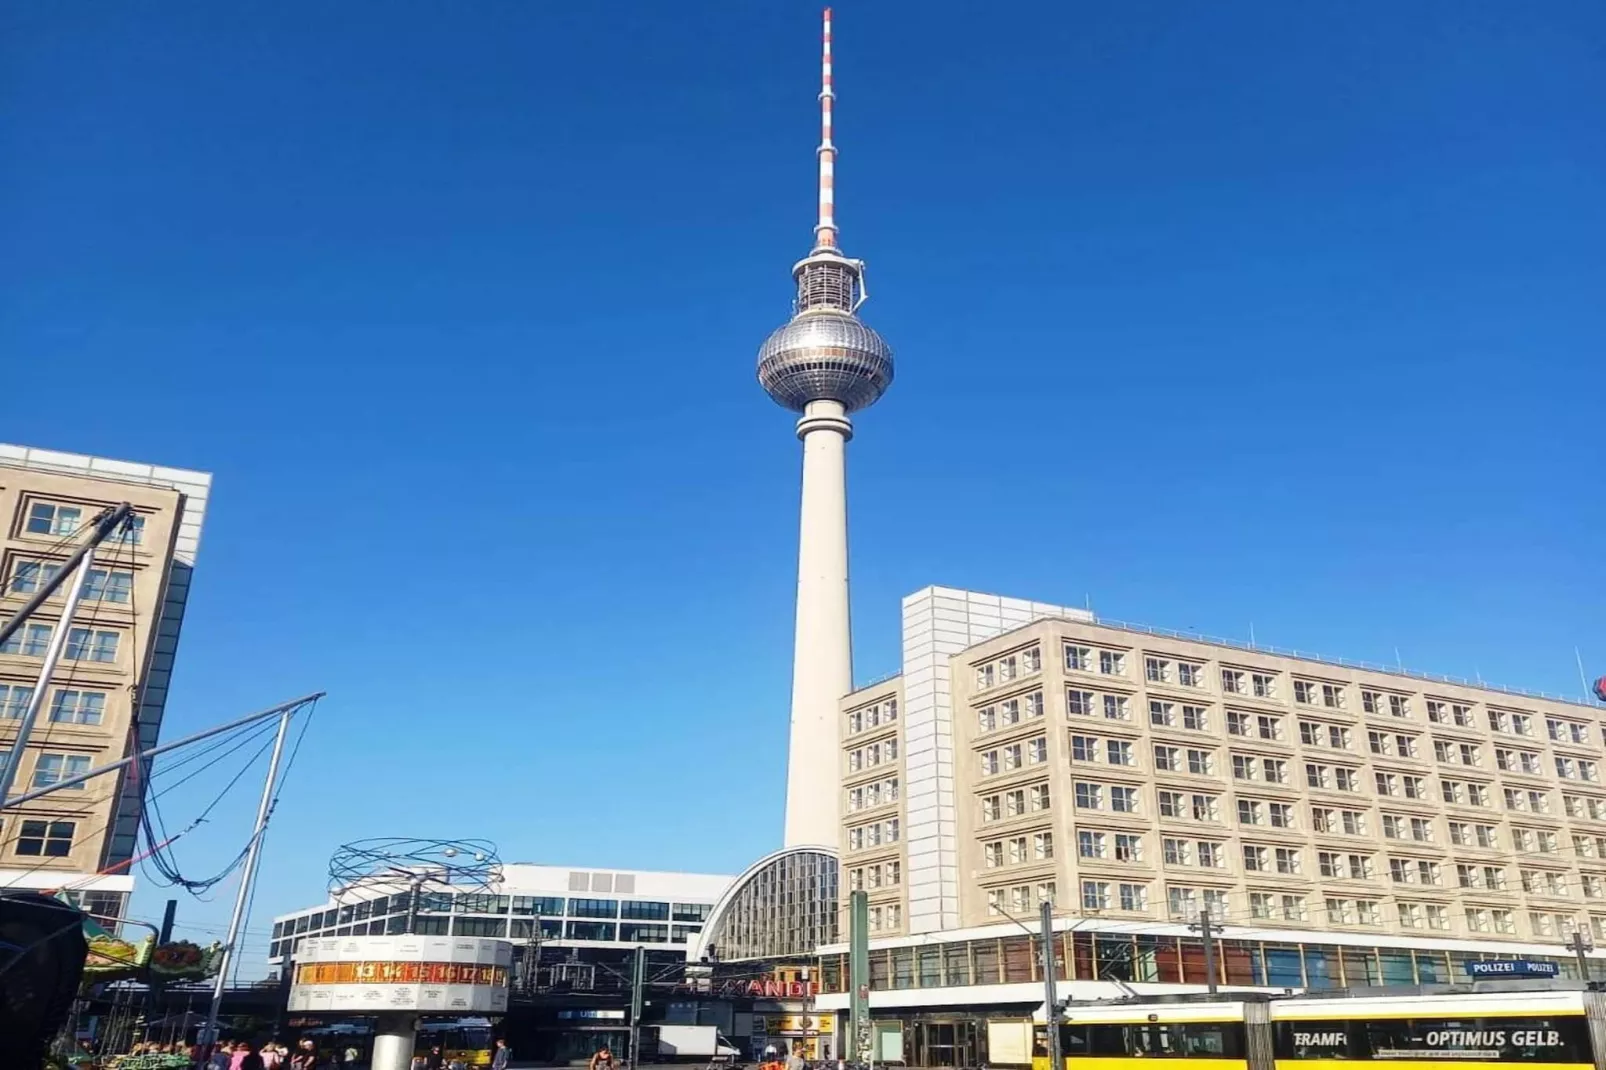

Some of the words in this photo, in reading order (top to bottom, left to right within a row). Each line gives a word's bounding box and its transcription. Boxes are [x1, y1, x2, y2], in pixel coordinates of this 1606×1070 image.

[355, 963, 375, 979] 13
[438, 965, 456, 979] 16
[463, 966, 478, 980] 17
[1473, 963, 1515, 973] POLIZEI
[1526, 962, 1554, 973] POLIZEI
[1426, 1031, 1506, 1047] OPTIMUS
[1511, 1030, 1565, 1047] GELB.
